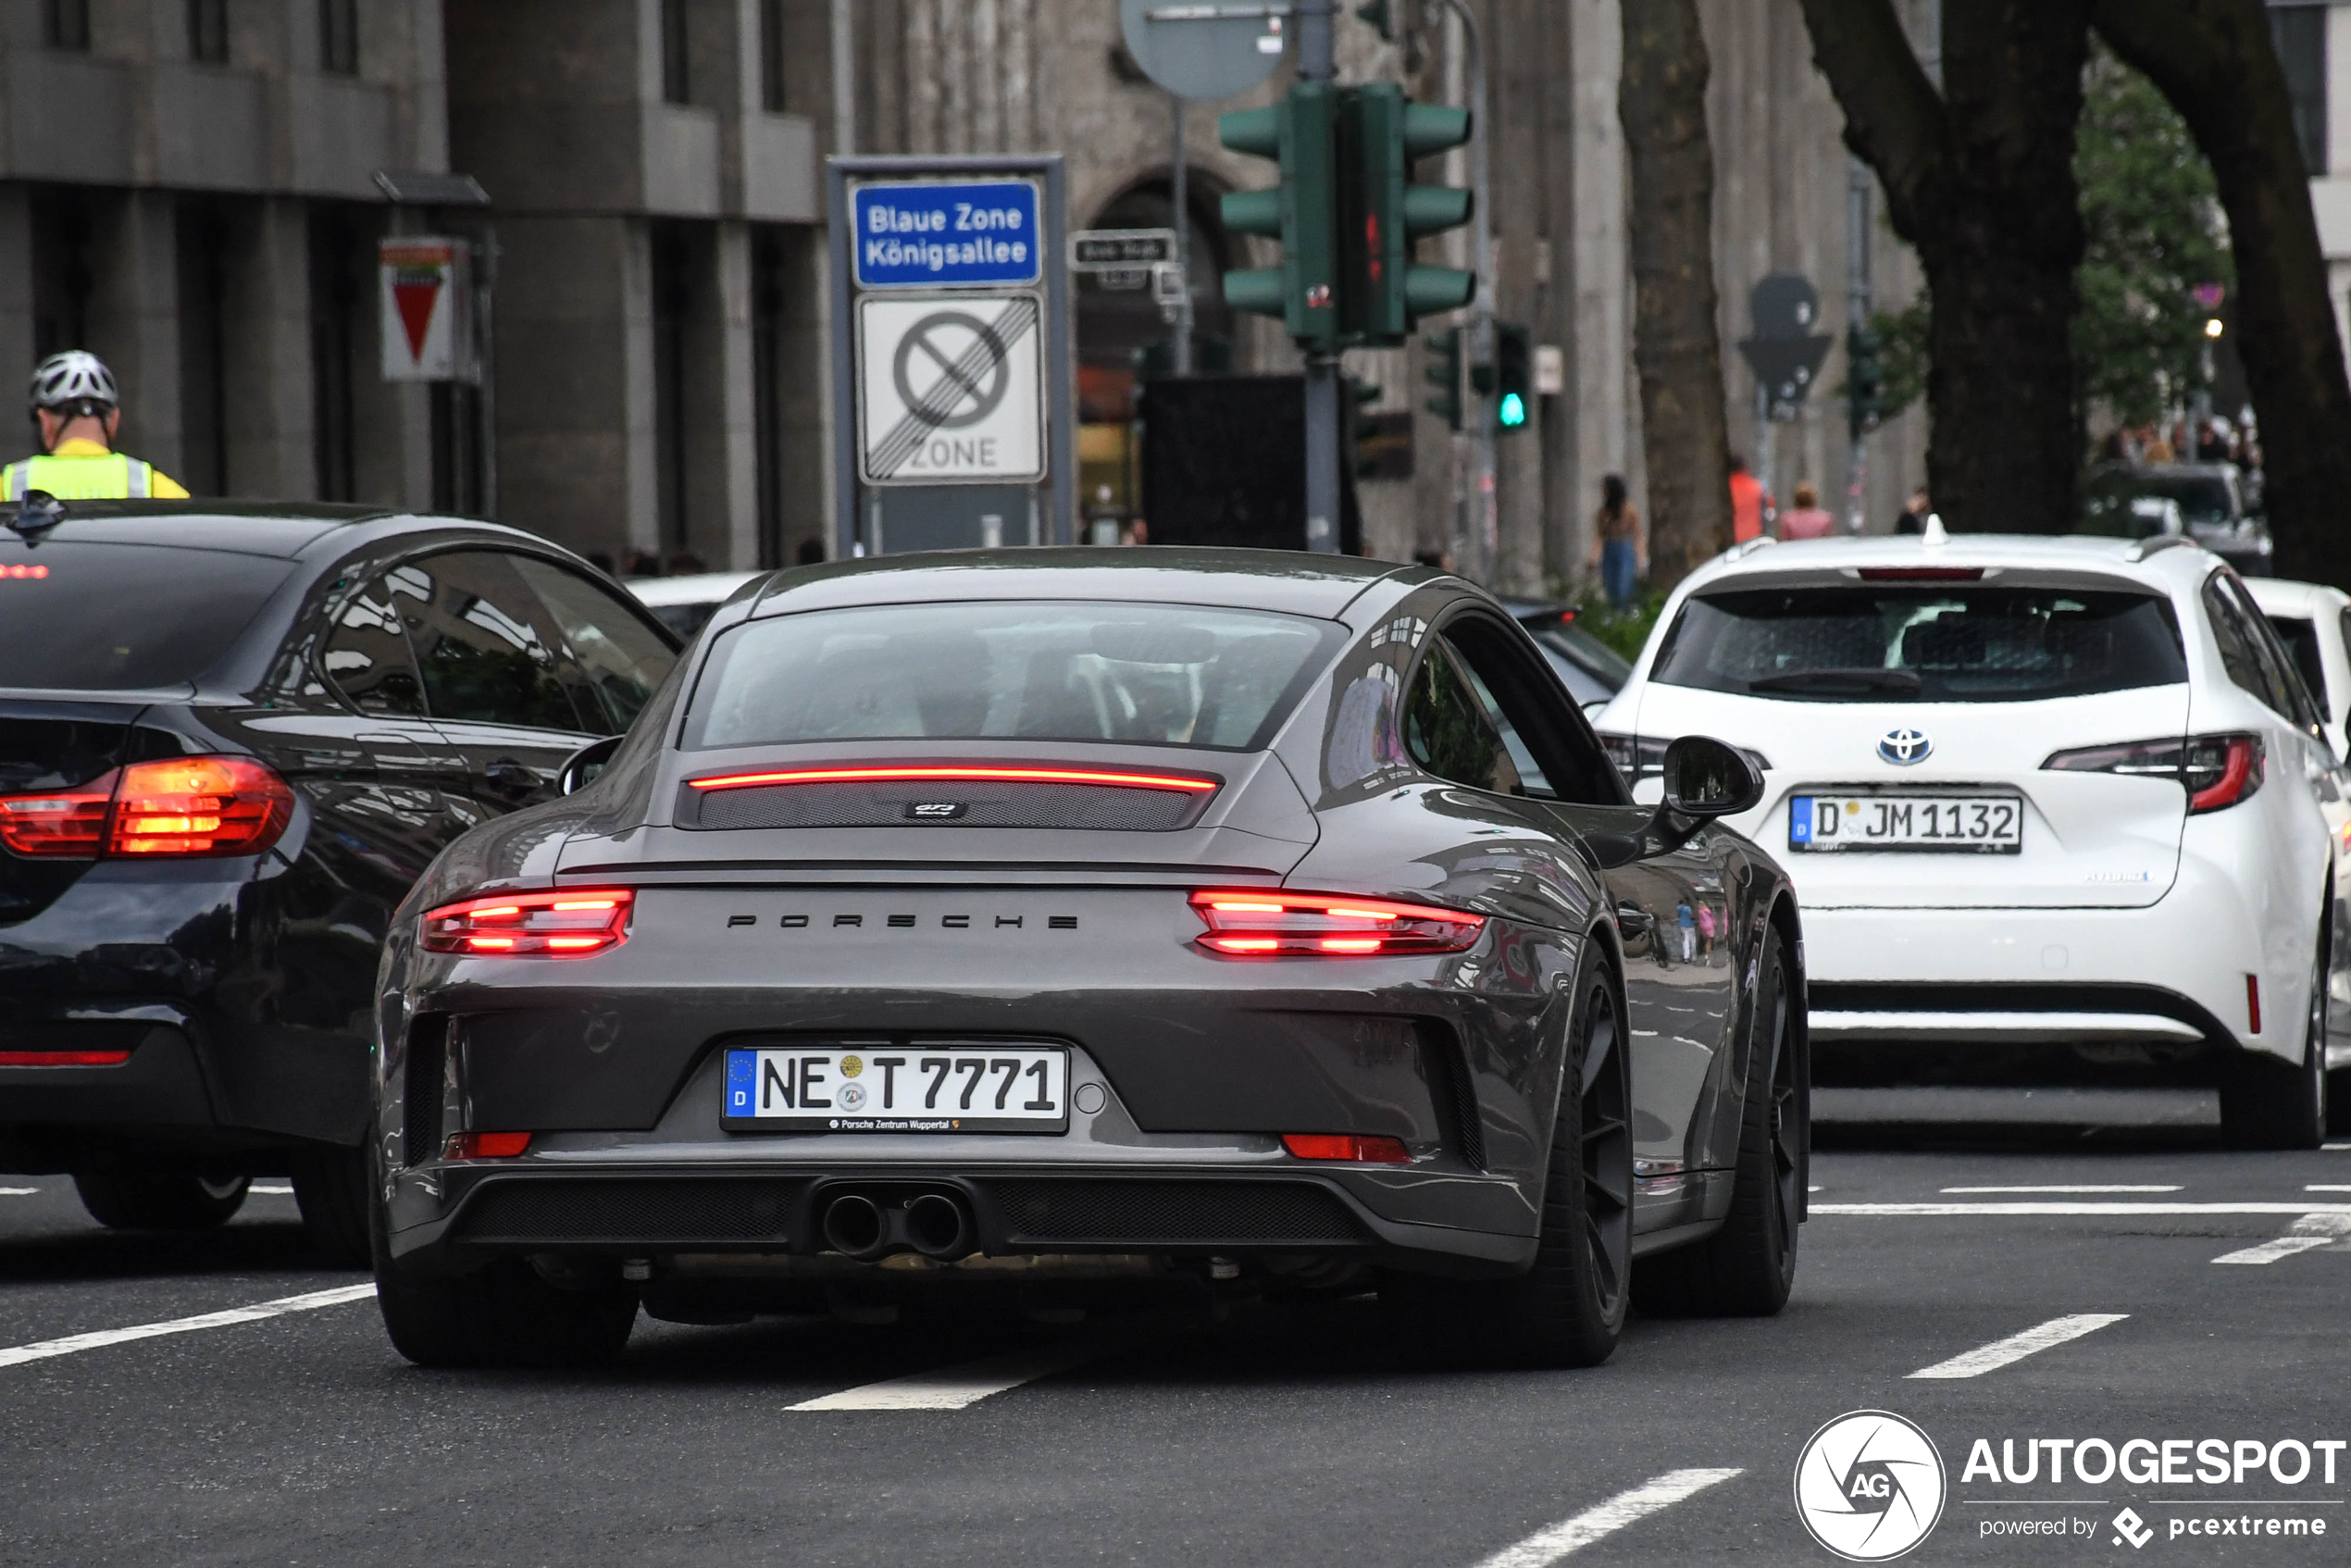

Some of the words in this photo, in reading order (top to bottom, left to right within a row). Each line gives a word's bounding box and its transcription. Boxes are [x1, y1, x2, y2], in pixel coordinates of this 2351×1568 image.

[868, 205, 947, 233] Blaue
[954, 202, 1023, 230] Zone
[865, 235, 1027, 272] Königsallee
[911, 437, 998, 468] ZONE
[1817, 803, 1839, 837] D
[1866, 803, 1912, 837] JM
[1921, 804, 2014, 839] 1132
[727, 914, 1078, 929] PORSCHE
[735, 1090, 746, 1106] D
[763, 1057, 832, 1110] NE
[873, 1057, 906, 1109] T
[920, 1057, 1056, 1111] 7771
[841, 1119, 875, 1129] Porsche
[876, 1119, 908, 1129] Zentrum
[909, 1119, 950, 1131] Wuppertal
